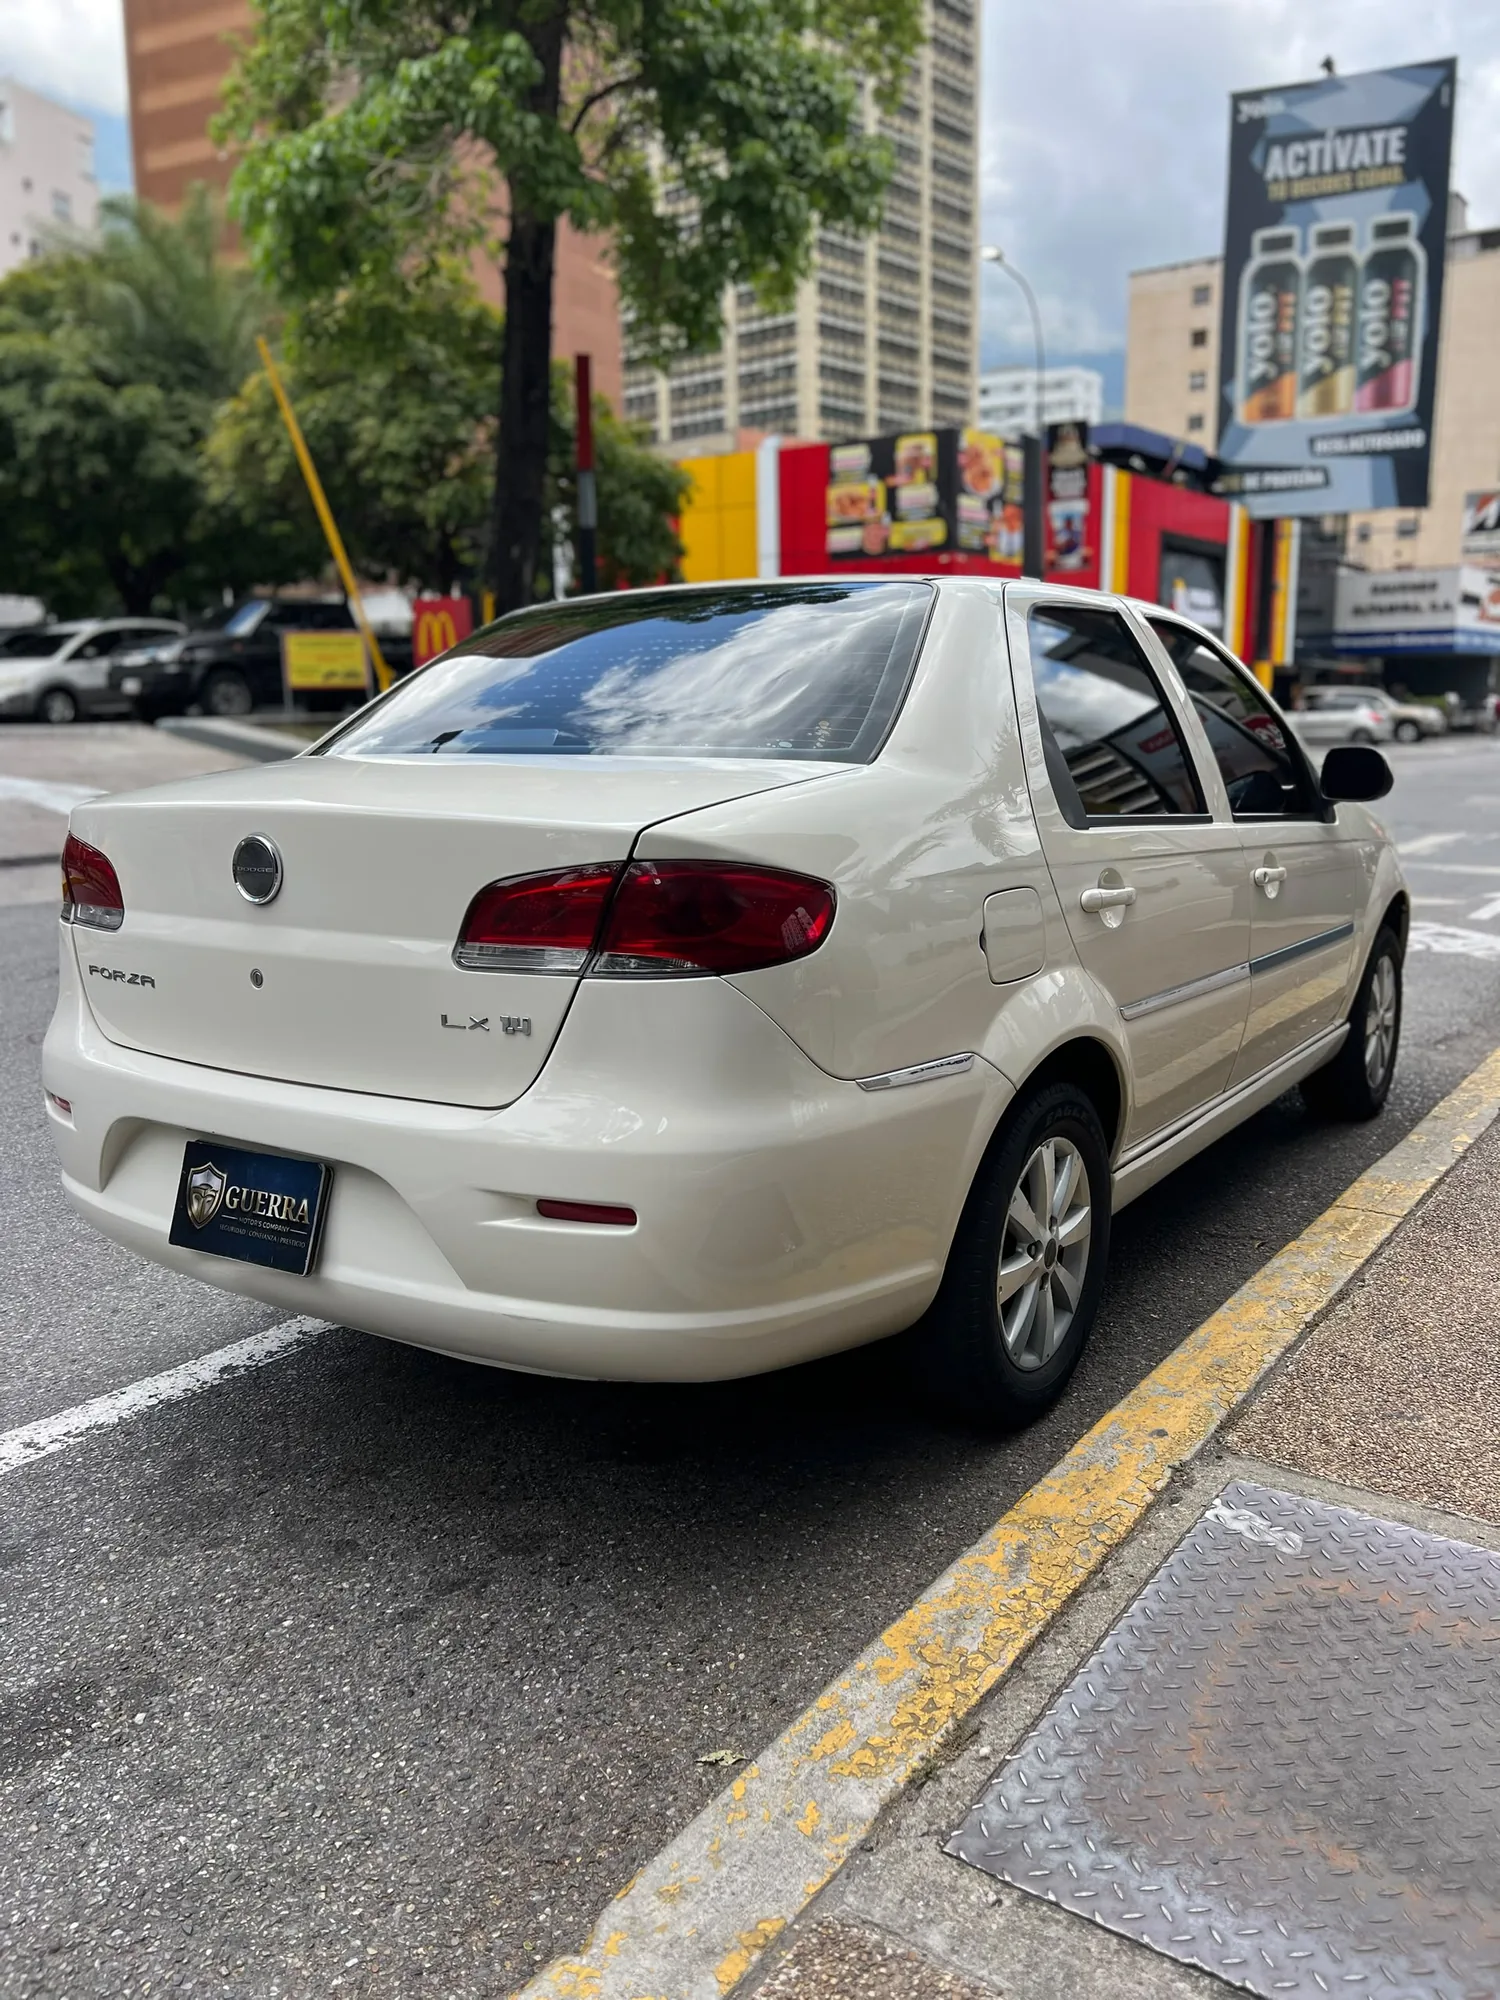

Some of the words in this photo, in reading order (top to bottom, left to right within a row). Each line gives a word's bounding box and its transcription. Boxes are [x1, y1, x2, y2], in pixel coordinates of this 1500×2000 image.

[1265, 126, 1408, 181] ACTÍVATE
[1247, 292, 1278, 380] yolo
[1302, 285, 1333, 374] yolo
[1360, 279, 1391, 370] yolo
[88, 964, 156, 989] FORZA
[440, 1013, 490, 1031] LX
[225, 1185, 310, 1225] GUERRA
[219, 1223, 247, 1235] SEGURIDAD
[248, 1230, 277, 1242] CONFIANZA
[279, 1236, 306, 1249] PRESTIGIO
[262, 1220, 290, 1233] COMPANY
